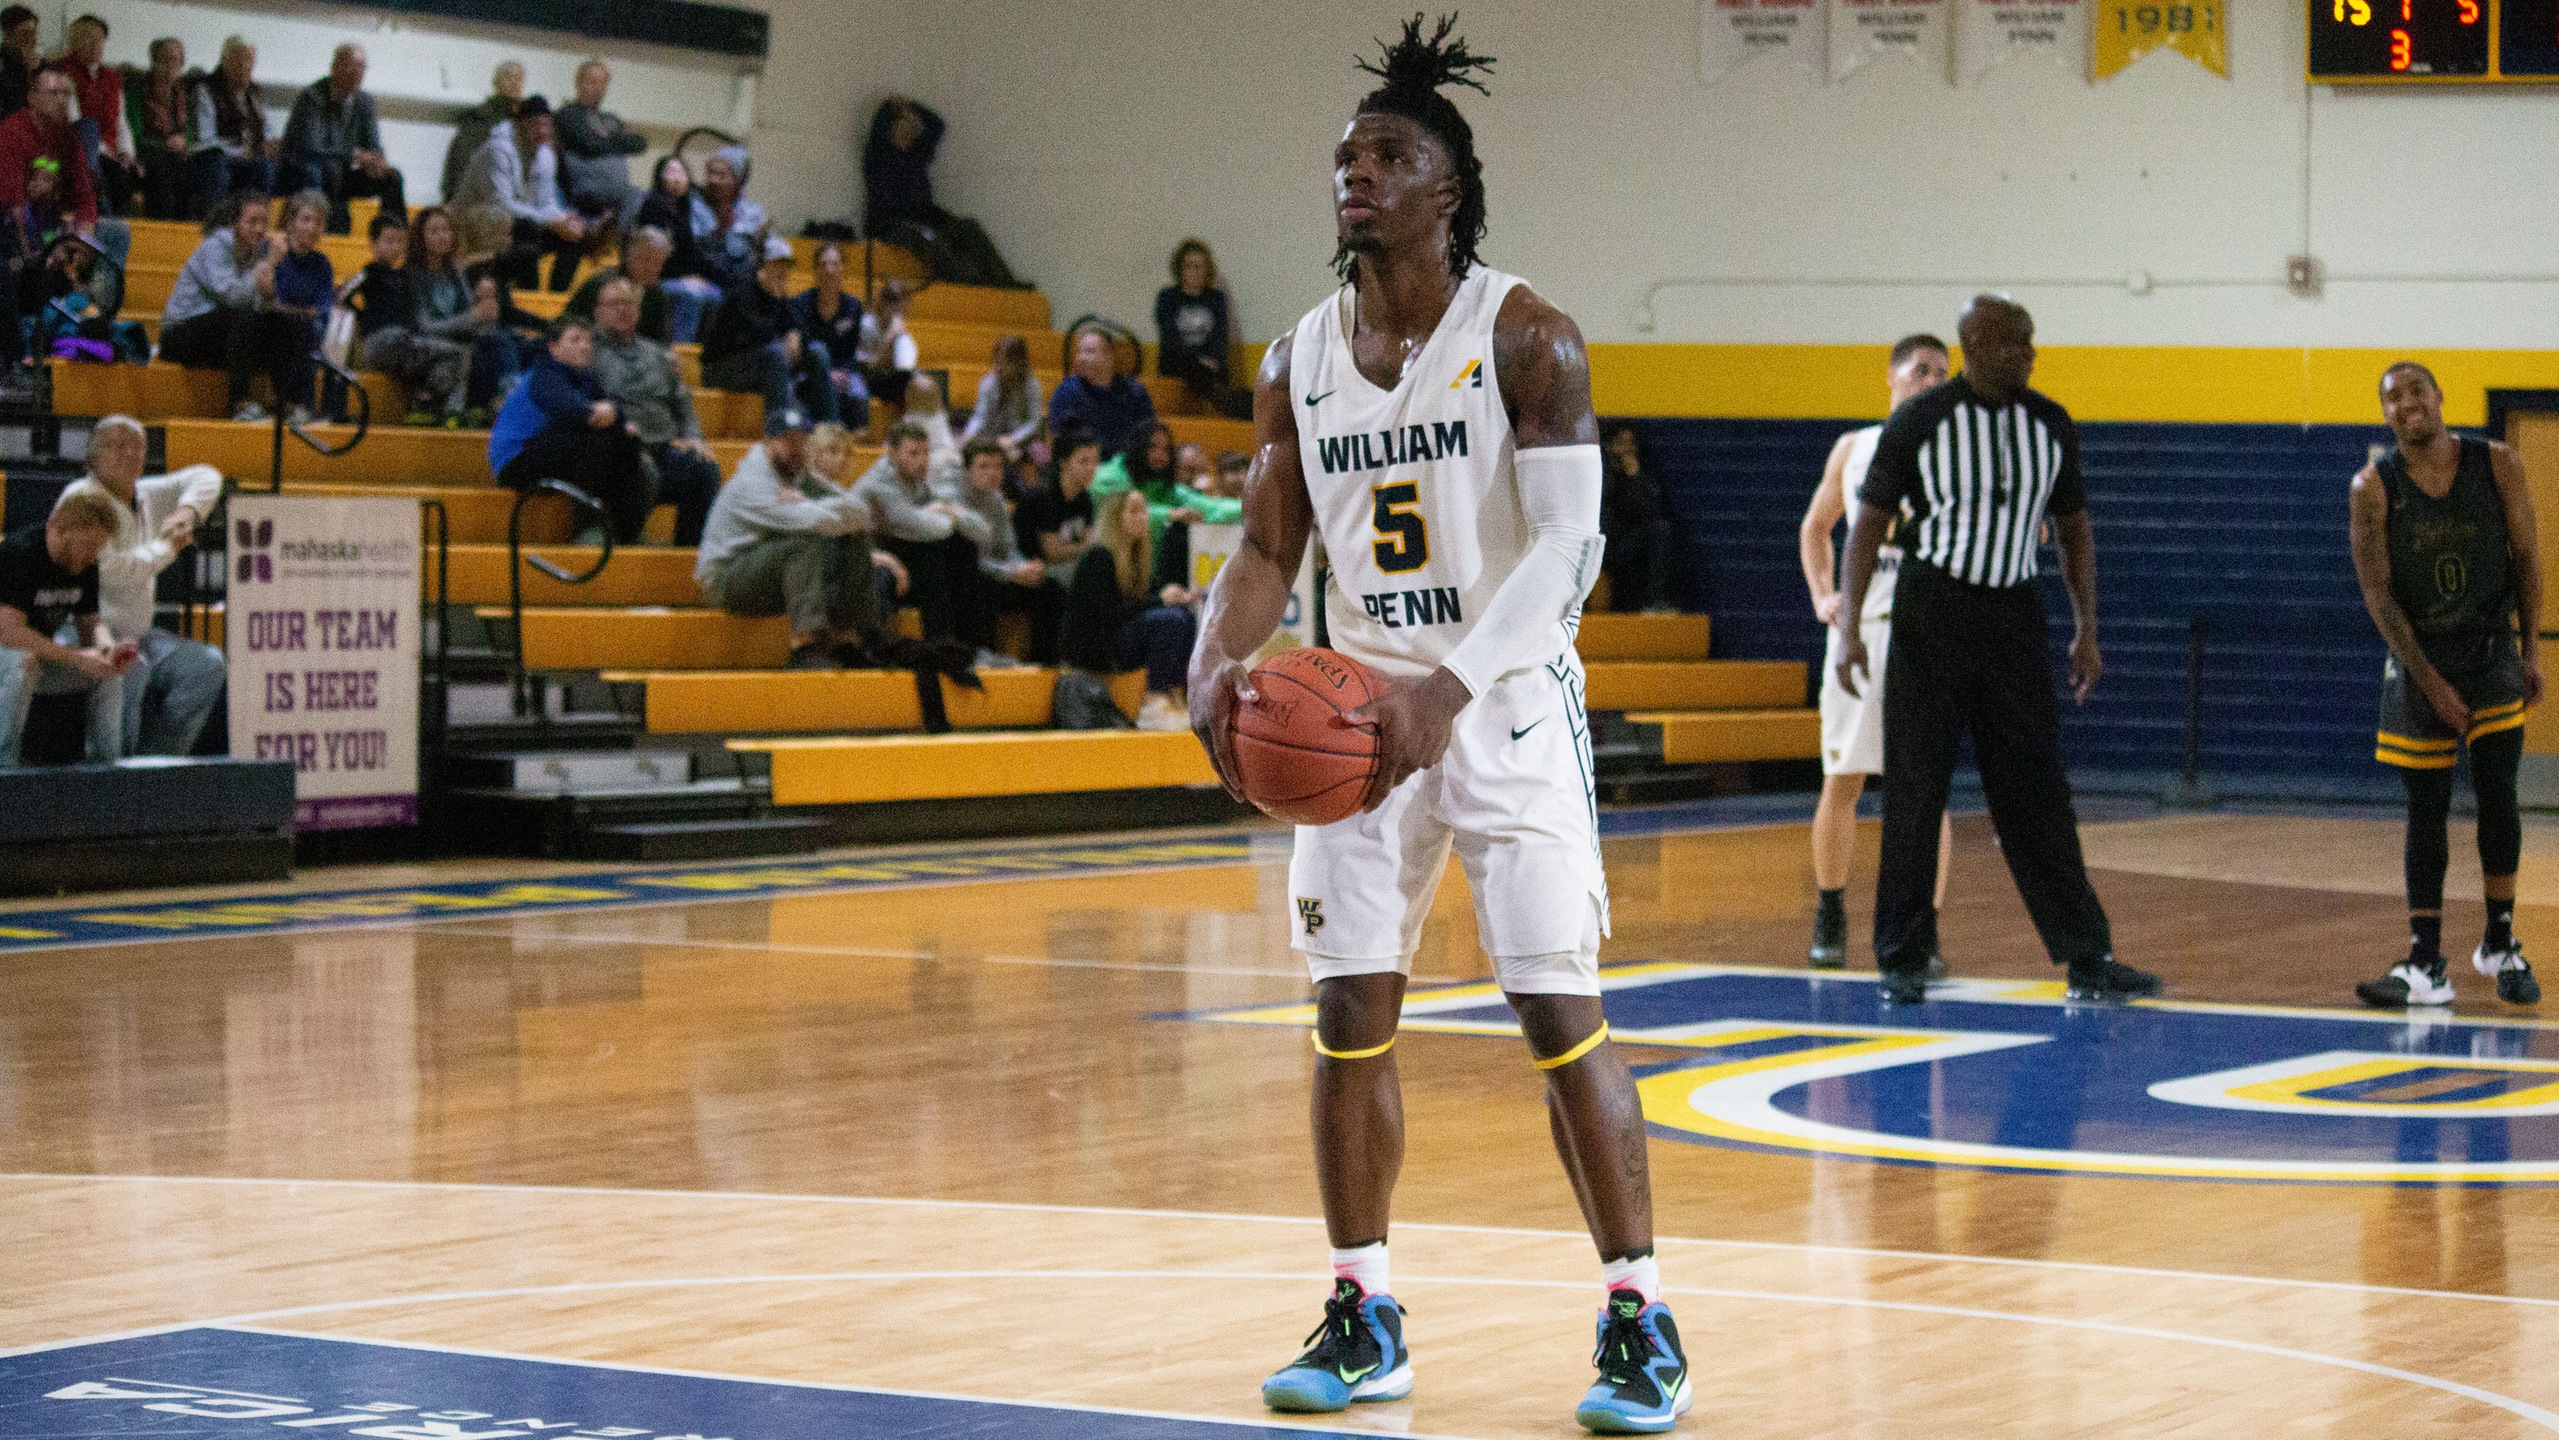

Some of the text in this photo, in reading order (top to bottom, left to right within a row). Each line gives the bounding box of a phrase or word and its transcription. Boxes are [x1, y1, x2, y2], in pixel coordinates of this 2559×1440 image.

[2119, 5, 2214, 33] 1981
[2391, 28, 2411, 70] 3
[1317, 420, 1469, 475] WILLIAM
[1371, 480, 1430, 576] 5
[1361, 586, 1463, 629] PENN
[248, 609, 397, 651] OUR TEAM
[265, 670, 379, 712] IS HERE
[255, 731, 318, 772] FOR
[43, 1380, 606, 1440] RICA
